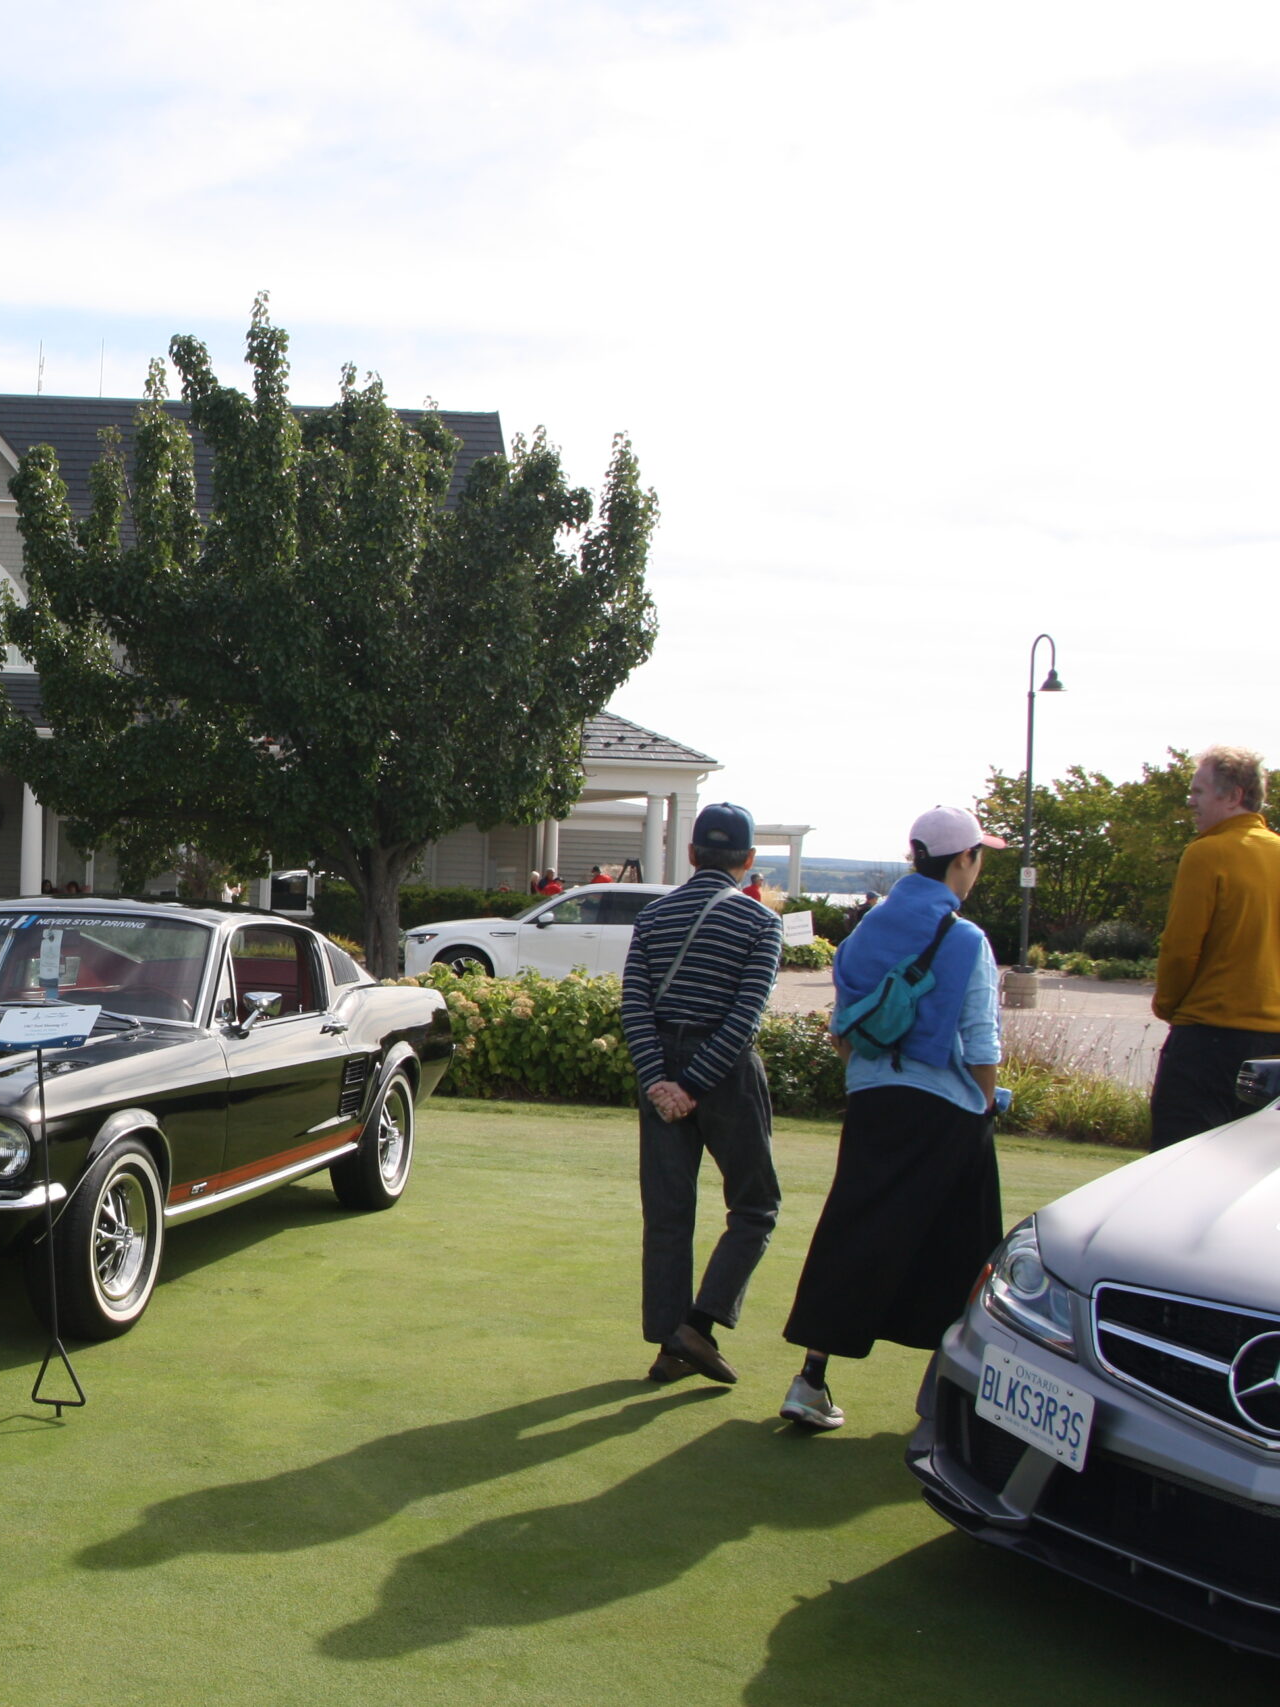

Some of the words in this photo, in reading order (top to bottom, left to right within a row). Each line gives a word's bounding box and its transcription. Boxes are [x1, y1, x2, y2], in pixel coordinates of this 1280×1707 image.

[36, 918, 72, 926] NEVER
[72, 919, 101, 927] STOP
[101, 920, 147, 929] DRIVING
[981, 1364, 1084, 1449] BLKS3R3S
